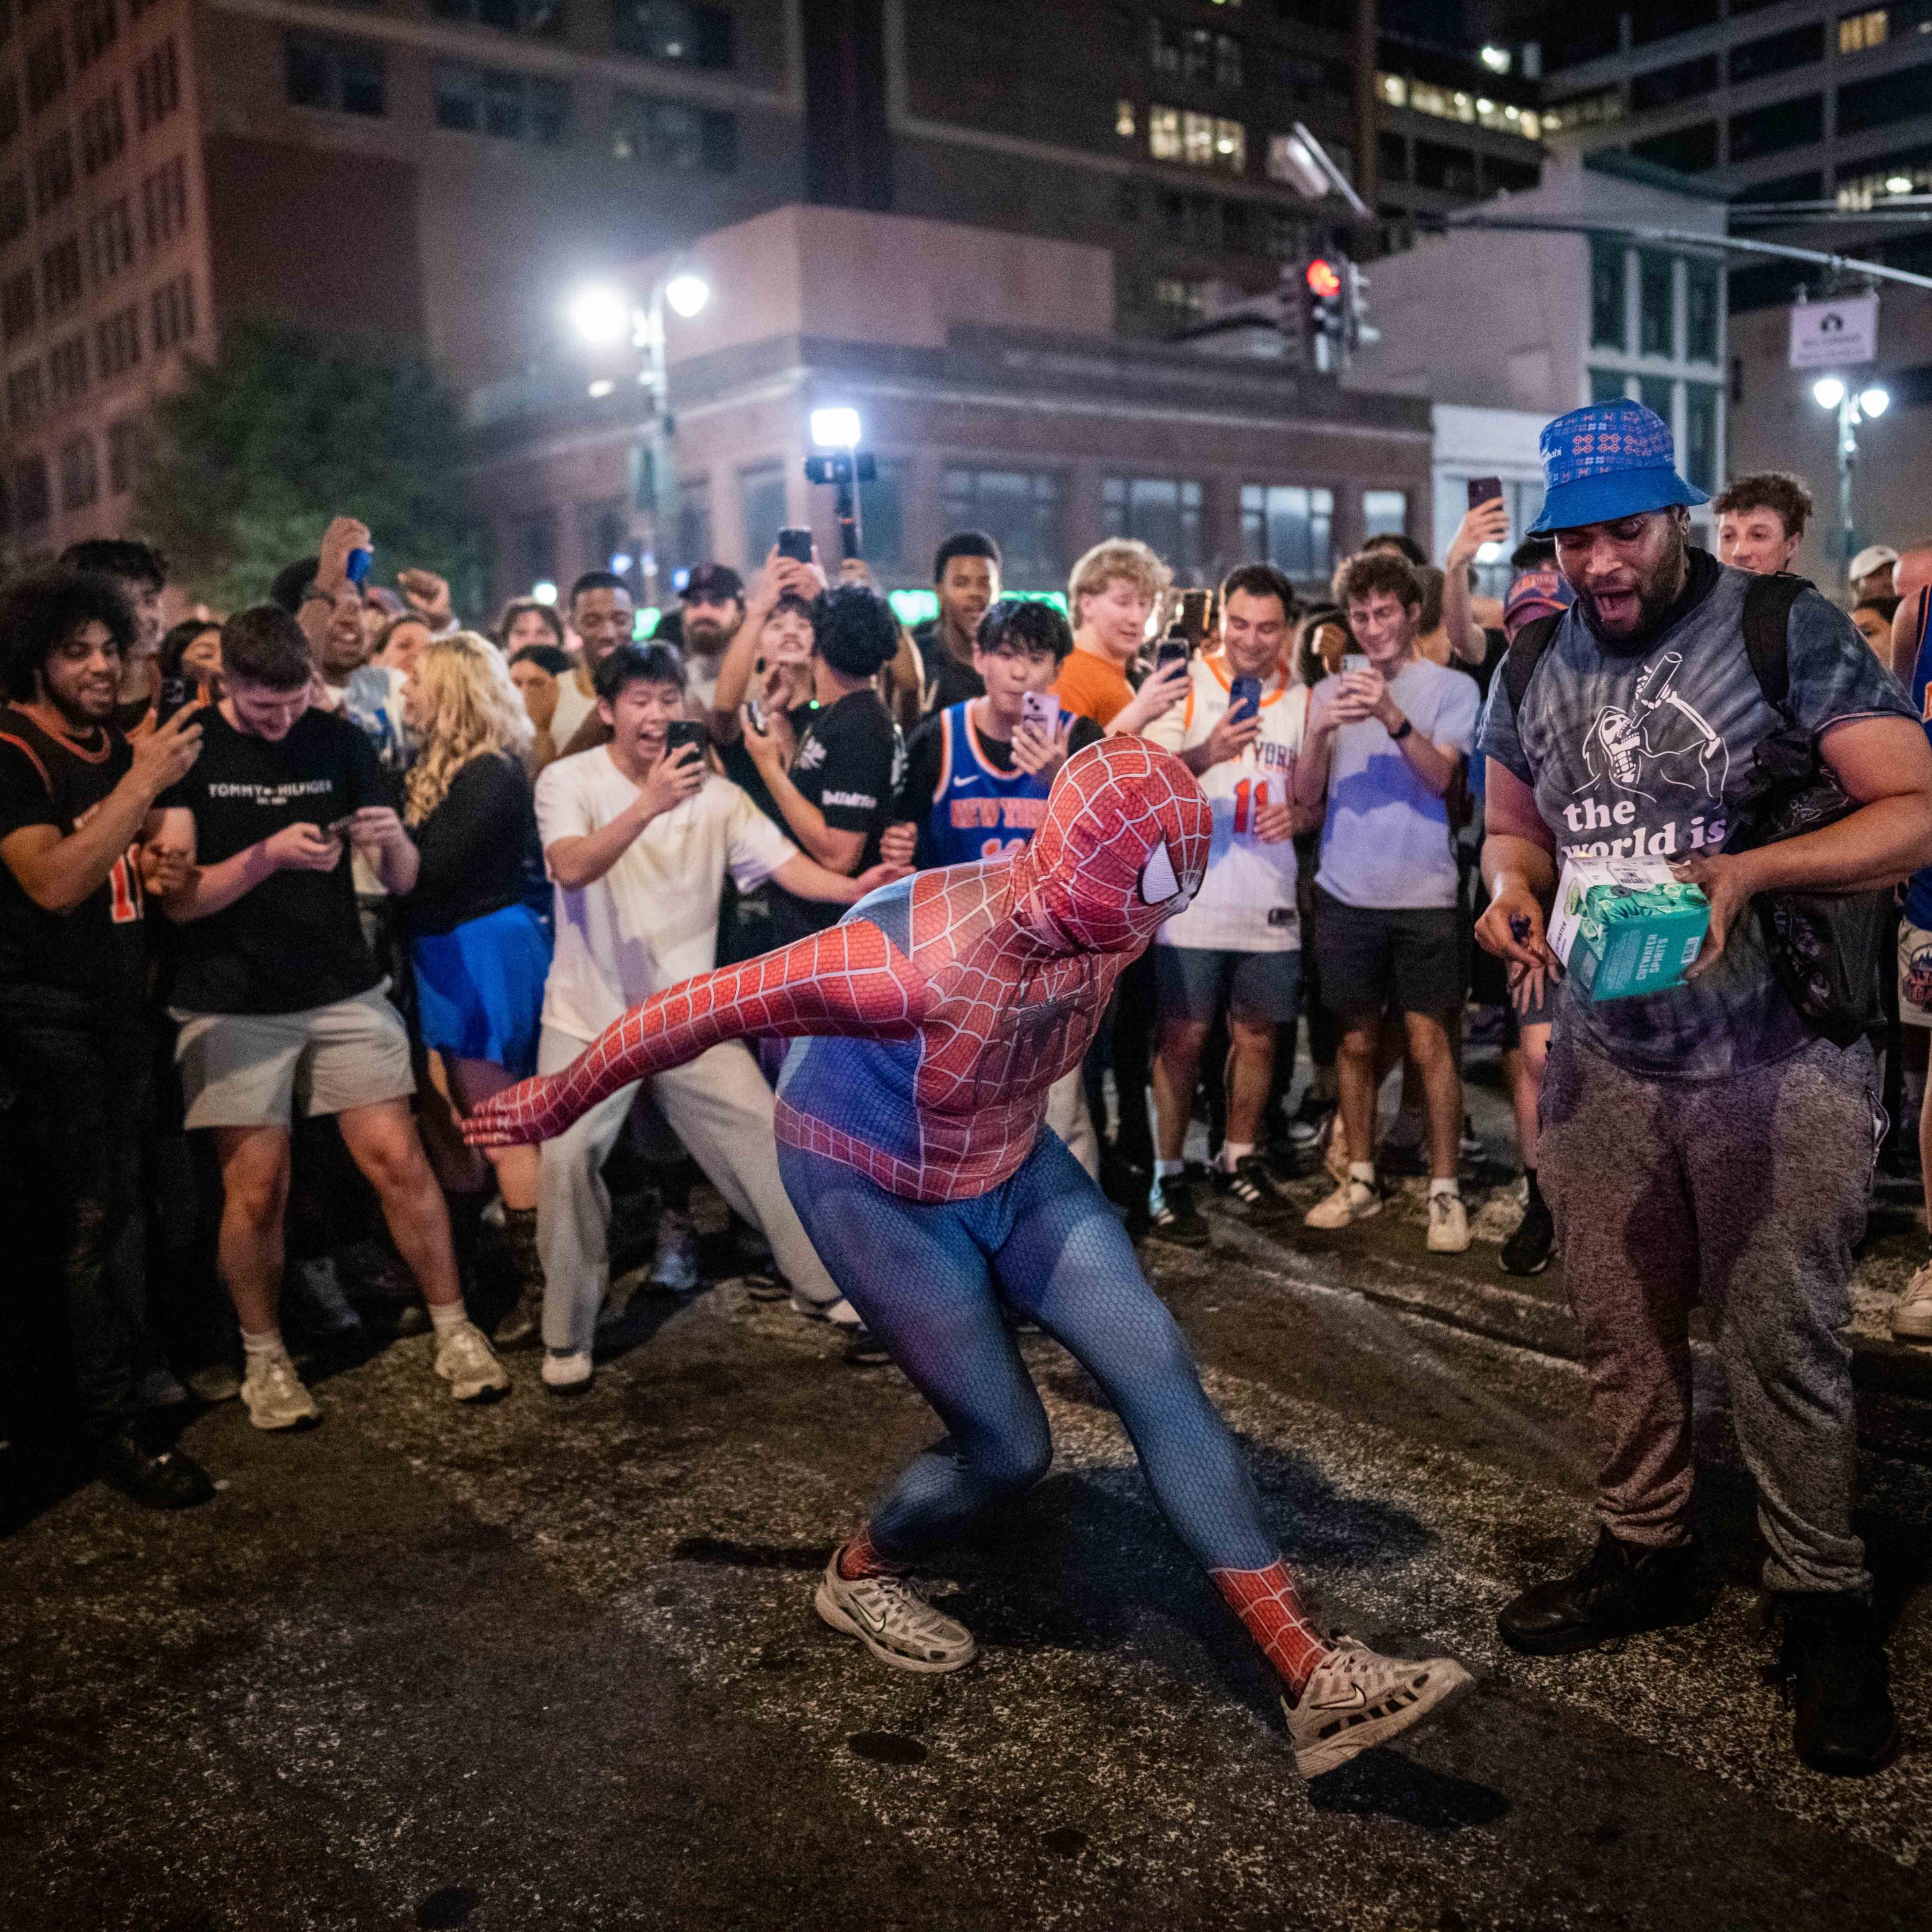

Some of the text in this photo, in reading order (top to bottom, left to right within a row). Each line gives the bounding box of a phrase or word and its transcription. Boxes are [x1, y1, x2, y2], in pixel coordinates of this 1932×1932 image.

[209, 784, 262, 798] TOMMY
[1562, 798, 1635, 832] the
[1561, 816, 1727, 859] world is
[1635, 934, 1658, 980] CUTWATER
[1650, 938, 1668, 973] SPIRITS
